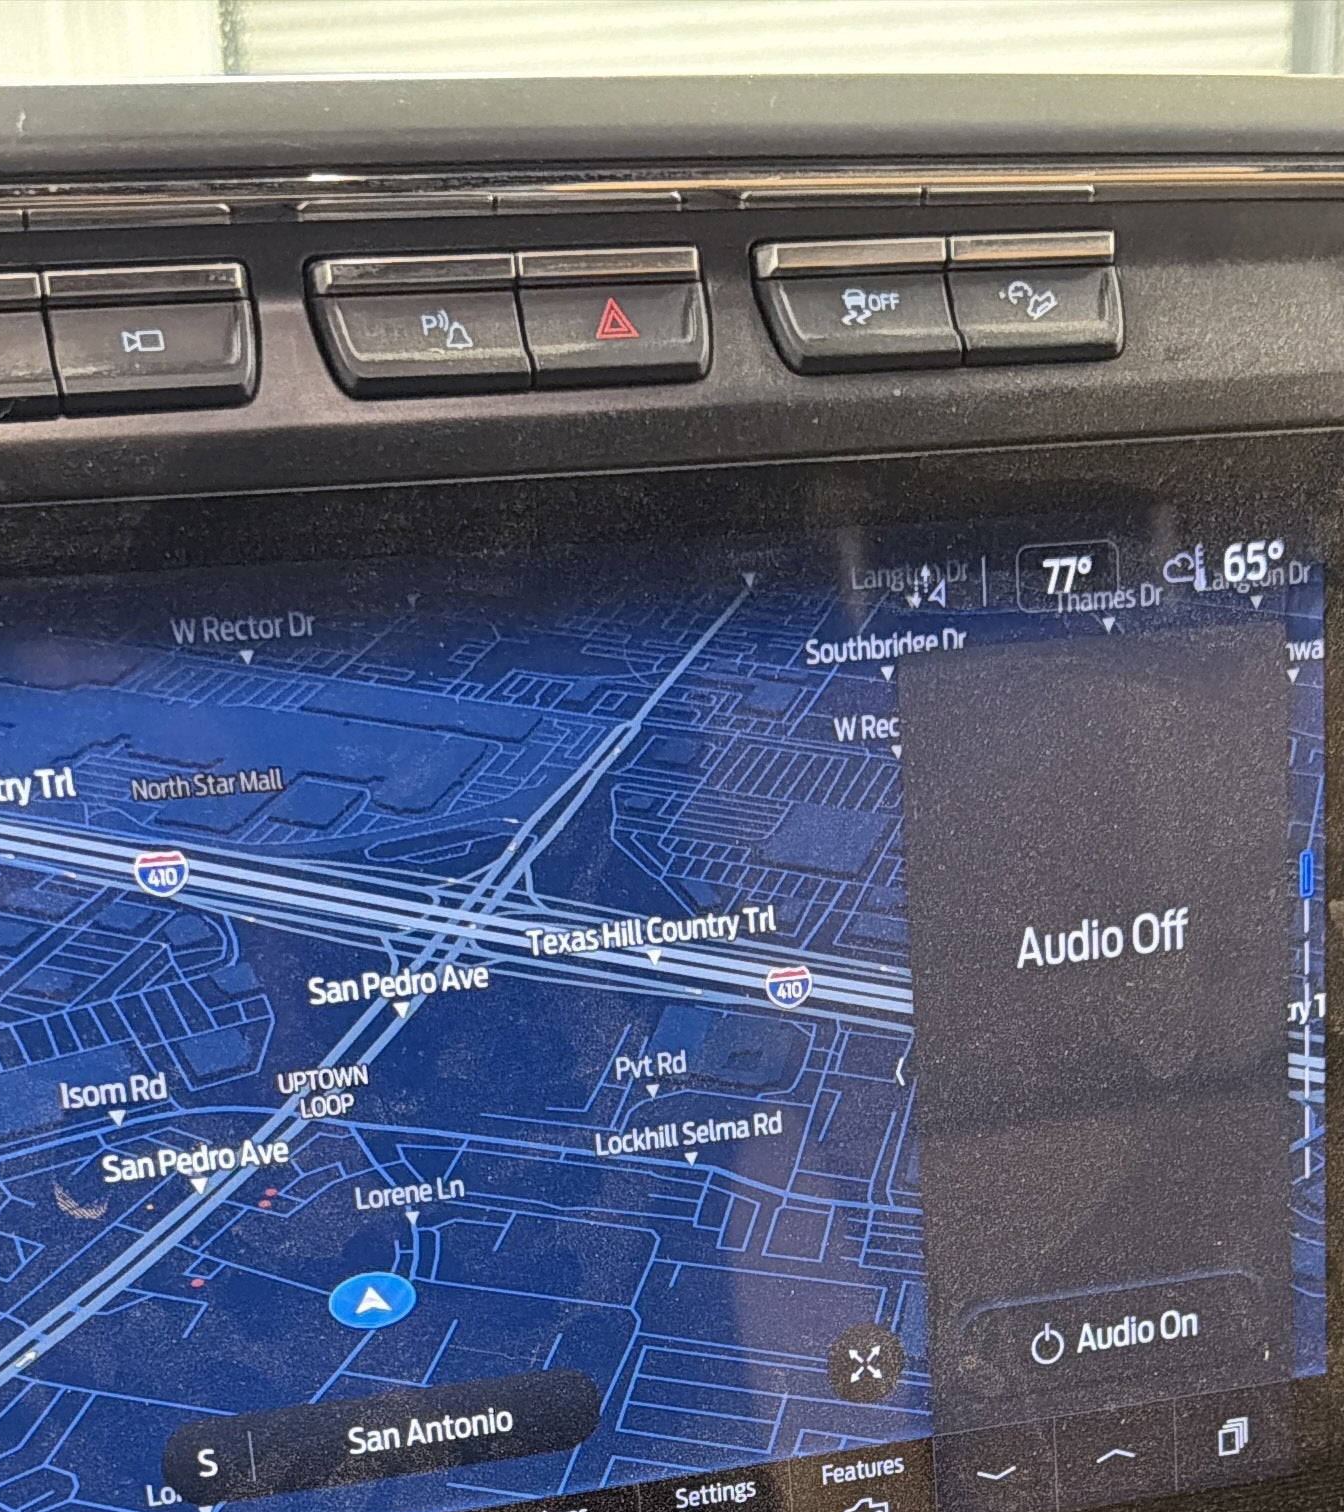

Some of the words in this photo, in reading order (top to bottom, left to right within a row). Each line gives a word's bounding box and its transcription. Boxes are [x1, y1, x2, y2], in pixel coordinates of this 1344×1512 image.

[868, 292, 900, 312] OFF
[946, 559, 970, 583] Dr
[1042, 555, 1093, 594] 77°
[1223, 539, 1285, 583] 65°
[1289, 560, 1311, 585] Dr
[1056, 588, 1136, 614] Thames
[1140, 582, 1165, 607] Dr
[170, 618, 199, 645] W
[203, 613, 284, 642] Rector
[287, 611, 316, 638] Dr
[805, 630, 939, 665] Southbridge
[942, 627, 967, 650] Dr
[833, 715, 857, 742] W
[33, 767, 76, 799] Trl
[131, 774, 192, 803] North
[194, 772, 235, 798] Star
[237, 768, 284, 795] Mall
[147, 867, 178, 887] 410
[526, 926, 599, 957] Texas
[602, 920, 643, 950] Hill
[646, 914, 741, 948] Country
[742, 905, 777, 935] Trl
[1017, 920, 1124, 969] Audio
[1131, 907, 1190, 956] Off
[307, 974, 357, 1005] San
[360, 968, 437, 1000] Pedro
[438, 963, 490, 993] Ave
[775, 980, 804, 1000] 410
[277, 1064, 369, 1095] UPTOWN
[615, 1055, 653, 1080] Pvt
[656, 1050, 688, 1076] Rd
[59, 1077, 124, 1109] Isom
[128, 1072, 168, 1101] Rd
[299, 1093, 355, 1120] LOOP
[594, 1126, 680, 1159] Lockhill
[683, 1117, 751, 1150] Selma
[754, 1111, 783, 1138] Rd
[102, 1153, 153, 1185] San
[157, 1146, 236, 1179] Pedro
[237, 1139, 290, 1169] Ave
[354, 1181, 432, 1212] Lorene
[437, 1176, 465, 1202] Ln
[1076, 1315, 1157, 1354] Audio
[1160, 1309, 1199, 1341] On
[347, 1424, 404, 1456] San
[407, 1408, 514, 1447] Antonio
[196, 1448, 220, 1479] S
[821, 1455, 905, 1487] Features
[675, 1477, 756, 1511] Settings
